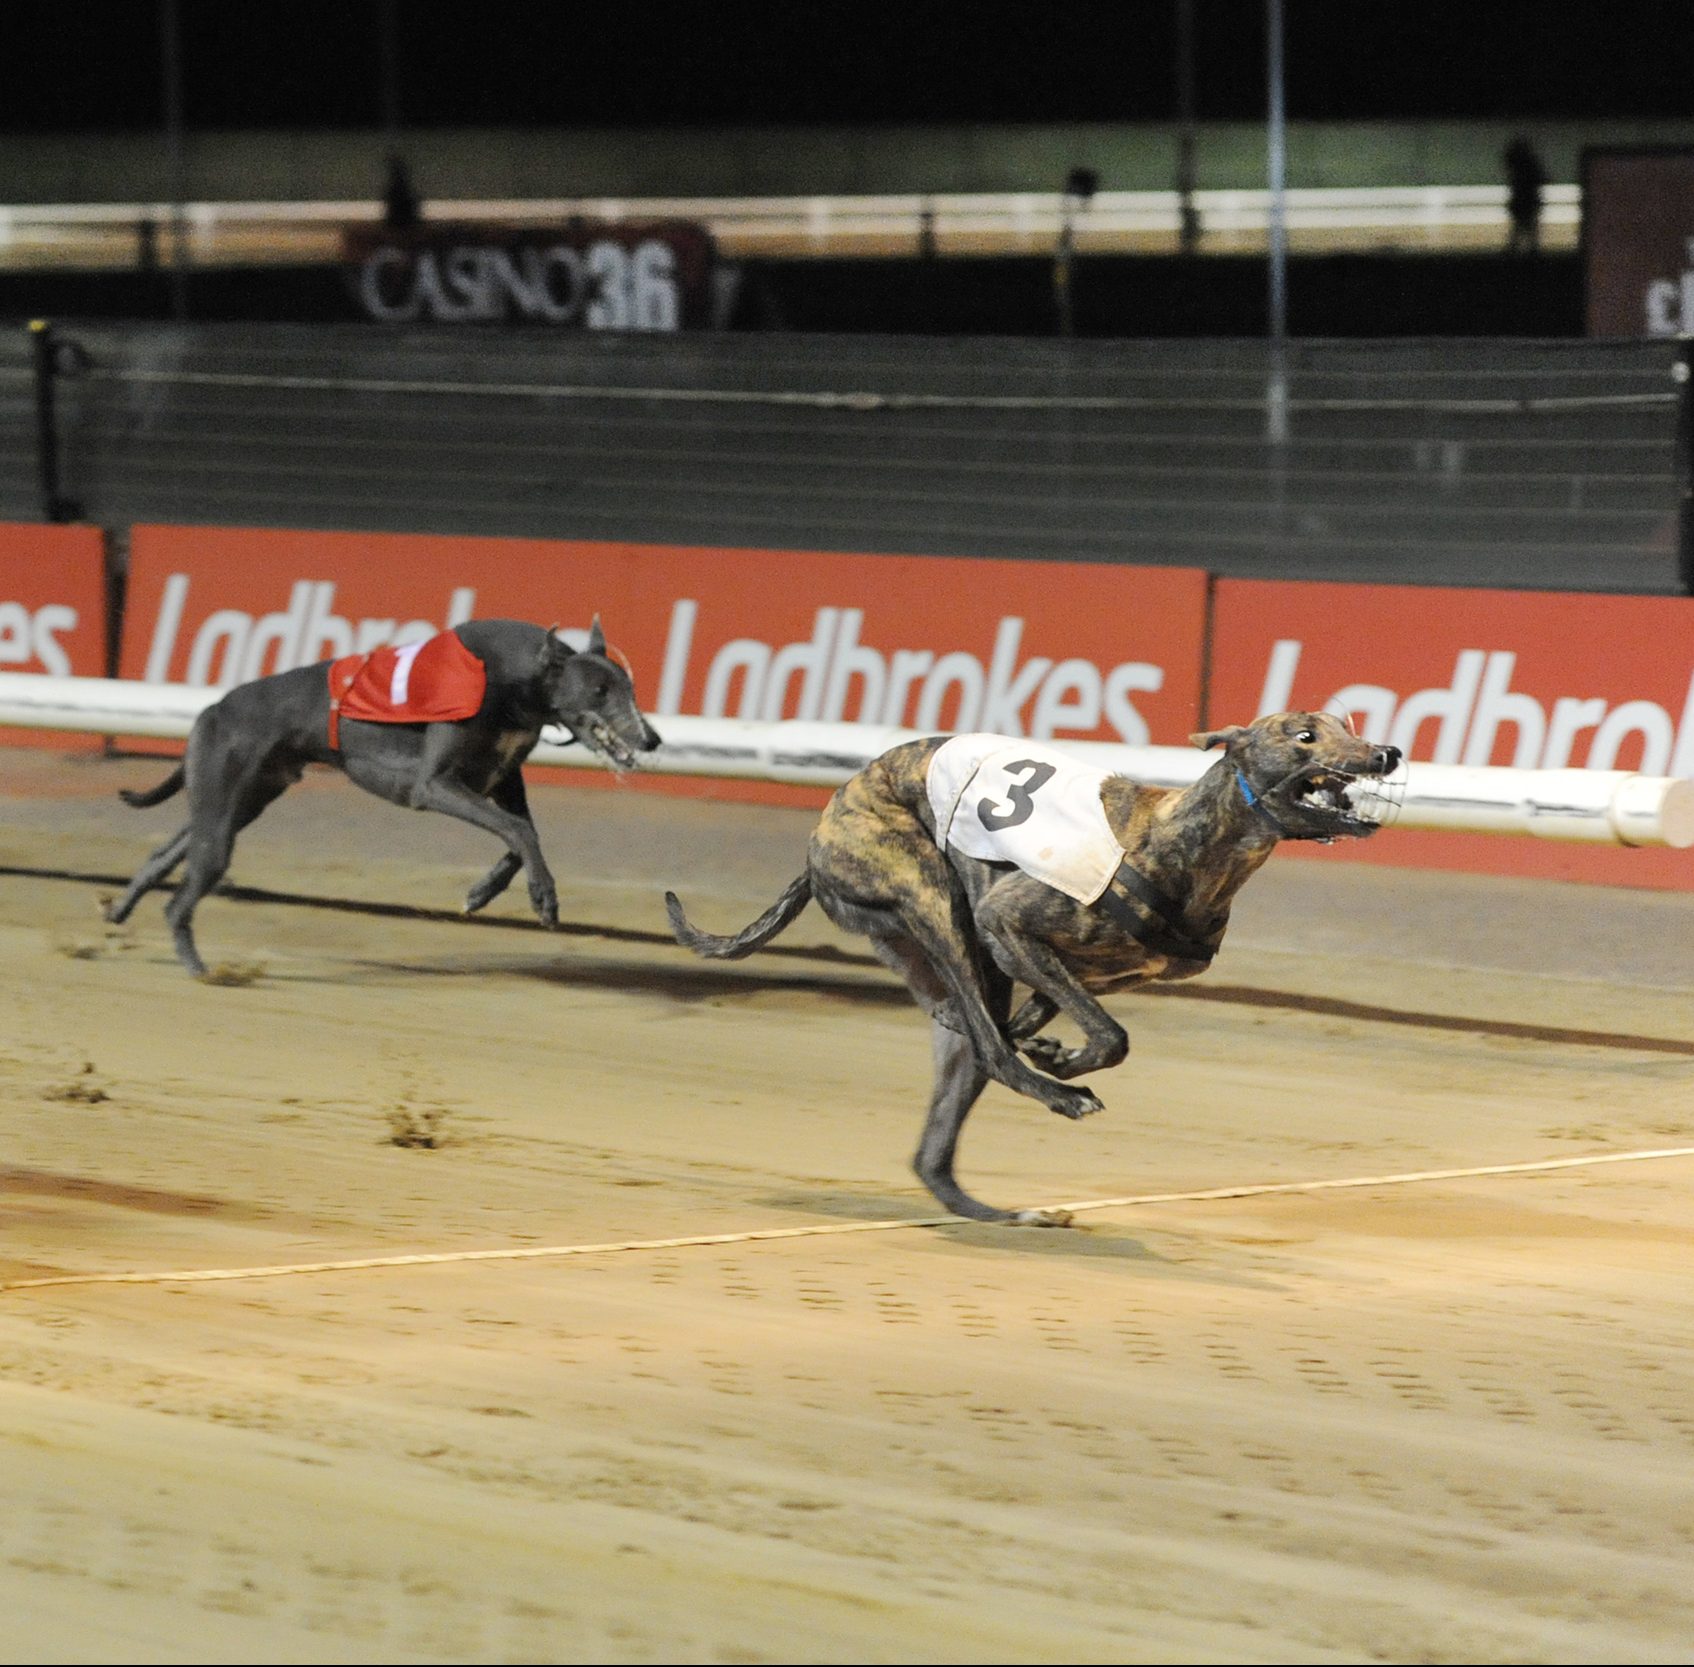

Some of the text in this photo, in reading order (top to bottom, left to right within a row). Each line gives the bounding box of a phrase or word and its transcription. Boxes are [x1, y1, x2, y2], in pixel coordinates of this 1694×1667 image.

[391, 642, 425, 706] 1
[656, 599, 1165, 746] Ladbrokes
[1256, 638, 1694, 777] Ladbro
[976, 758, 1057, 833] 3
